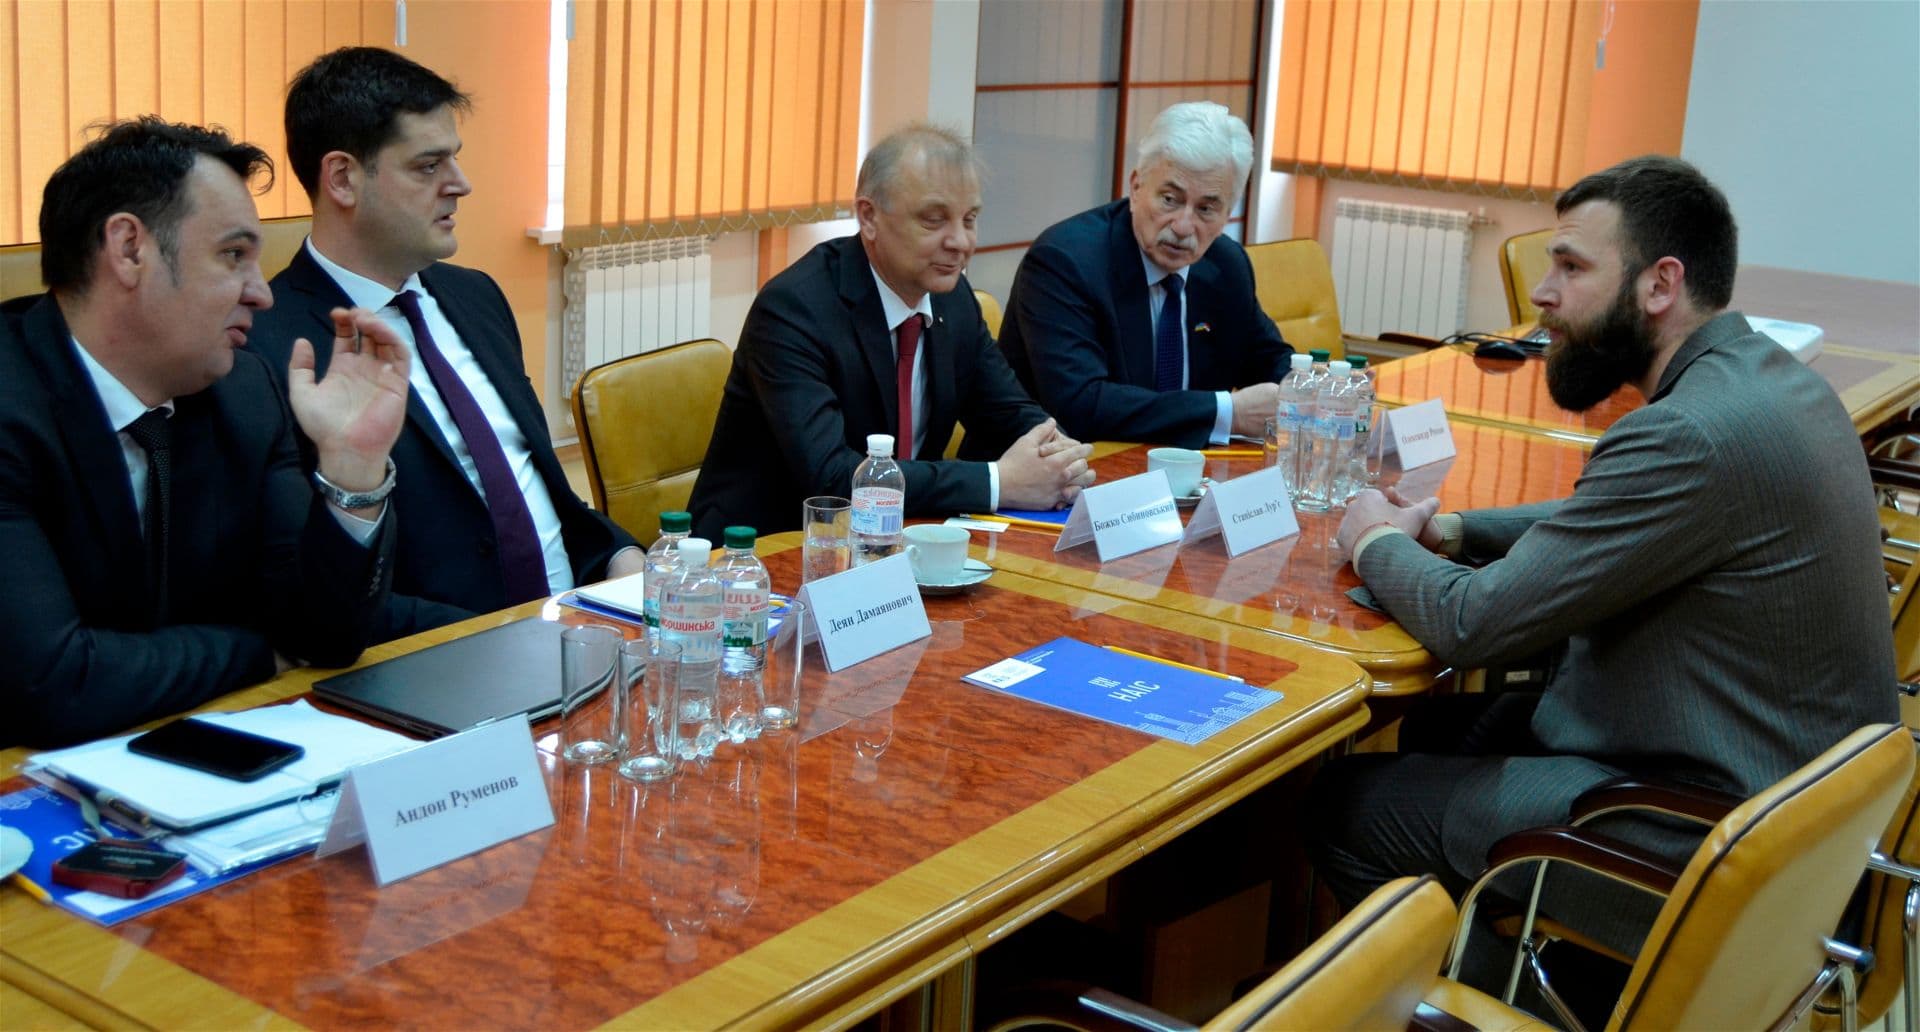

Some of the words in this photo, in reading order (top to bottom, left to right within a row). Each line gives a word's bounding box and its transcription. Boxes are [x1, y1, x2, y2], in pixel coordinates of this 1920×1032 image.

[829, 616, 854, 635] Деян
[856, 595, 914, 624] Дамаянович
[395, 799, 447, 827] Андон
[449, 776, 519, 809] Руменов
